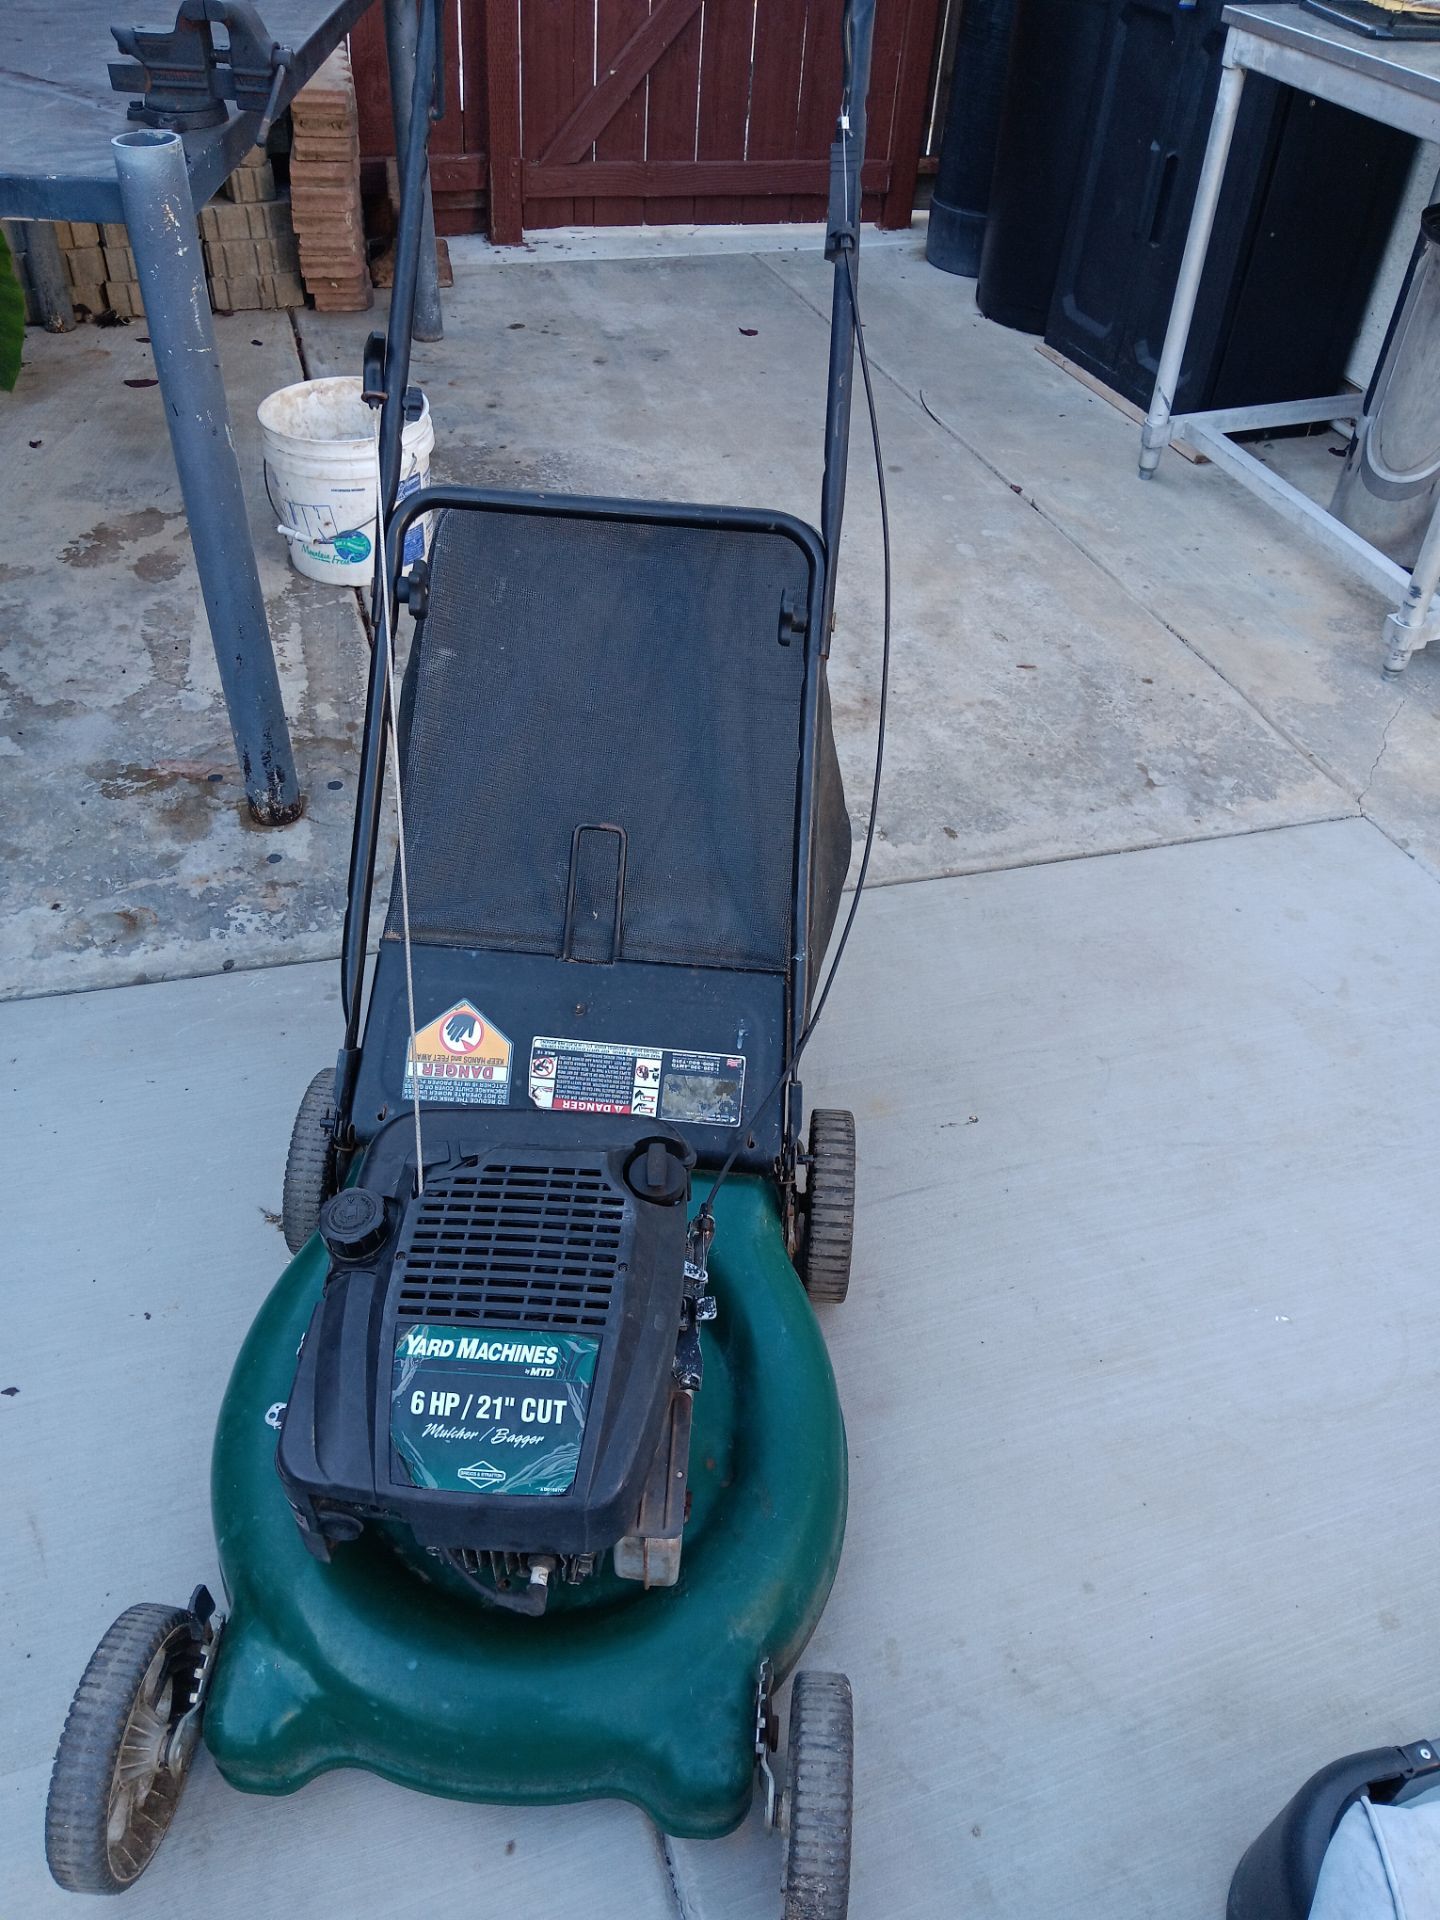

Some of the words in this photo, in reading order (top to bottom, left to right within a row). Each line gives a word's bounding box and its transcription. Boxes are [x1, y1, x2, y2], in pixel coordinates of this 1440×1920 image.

[421, 1062, 493, 1079] DANGER
[562, 1100, 611, 1112] DANGER
[406, 1334, 454, 1357] YARD
[455, 1337, 558, 1365] MACHINES
[529, 1367, 554, 1377] MTD
[410, 1390, 425, 1414] 6
[429, 1391, 460, 1417] HP
[460, 1393, 473, 1420] /
[475, 1394, 514, 1420] 21"
[520, 1397, 567, 1424] CUT
[421, 1422, 478, 1441] Mulcher
[479, 1425, 495, 1442] /
[490, 1427, 544, 1449] Bagger
